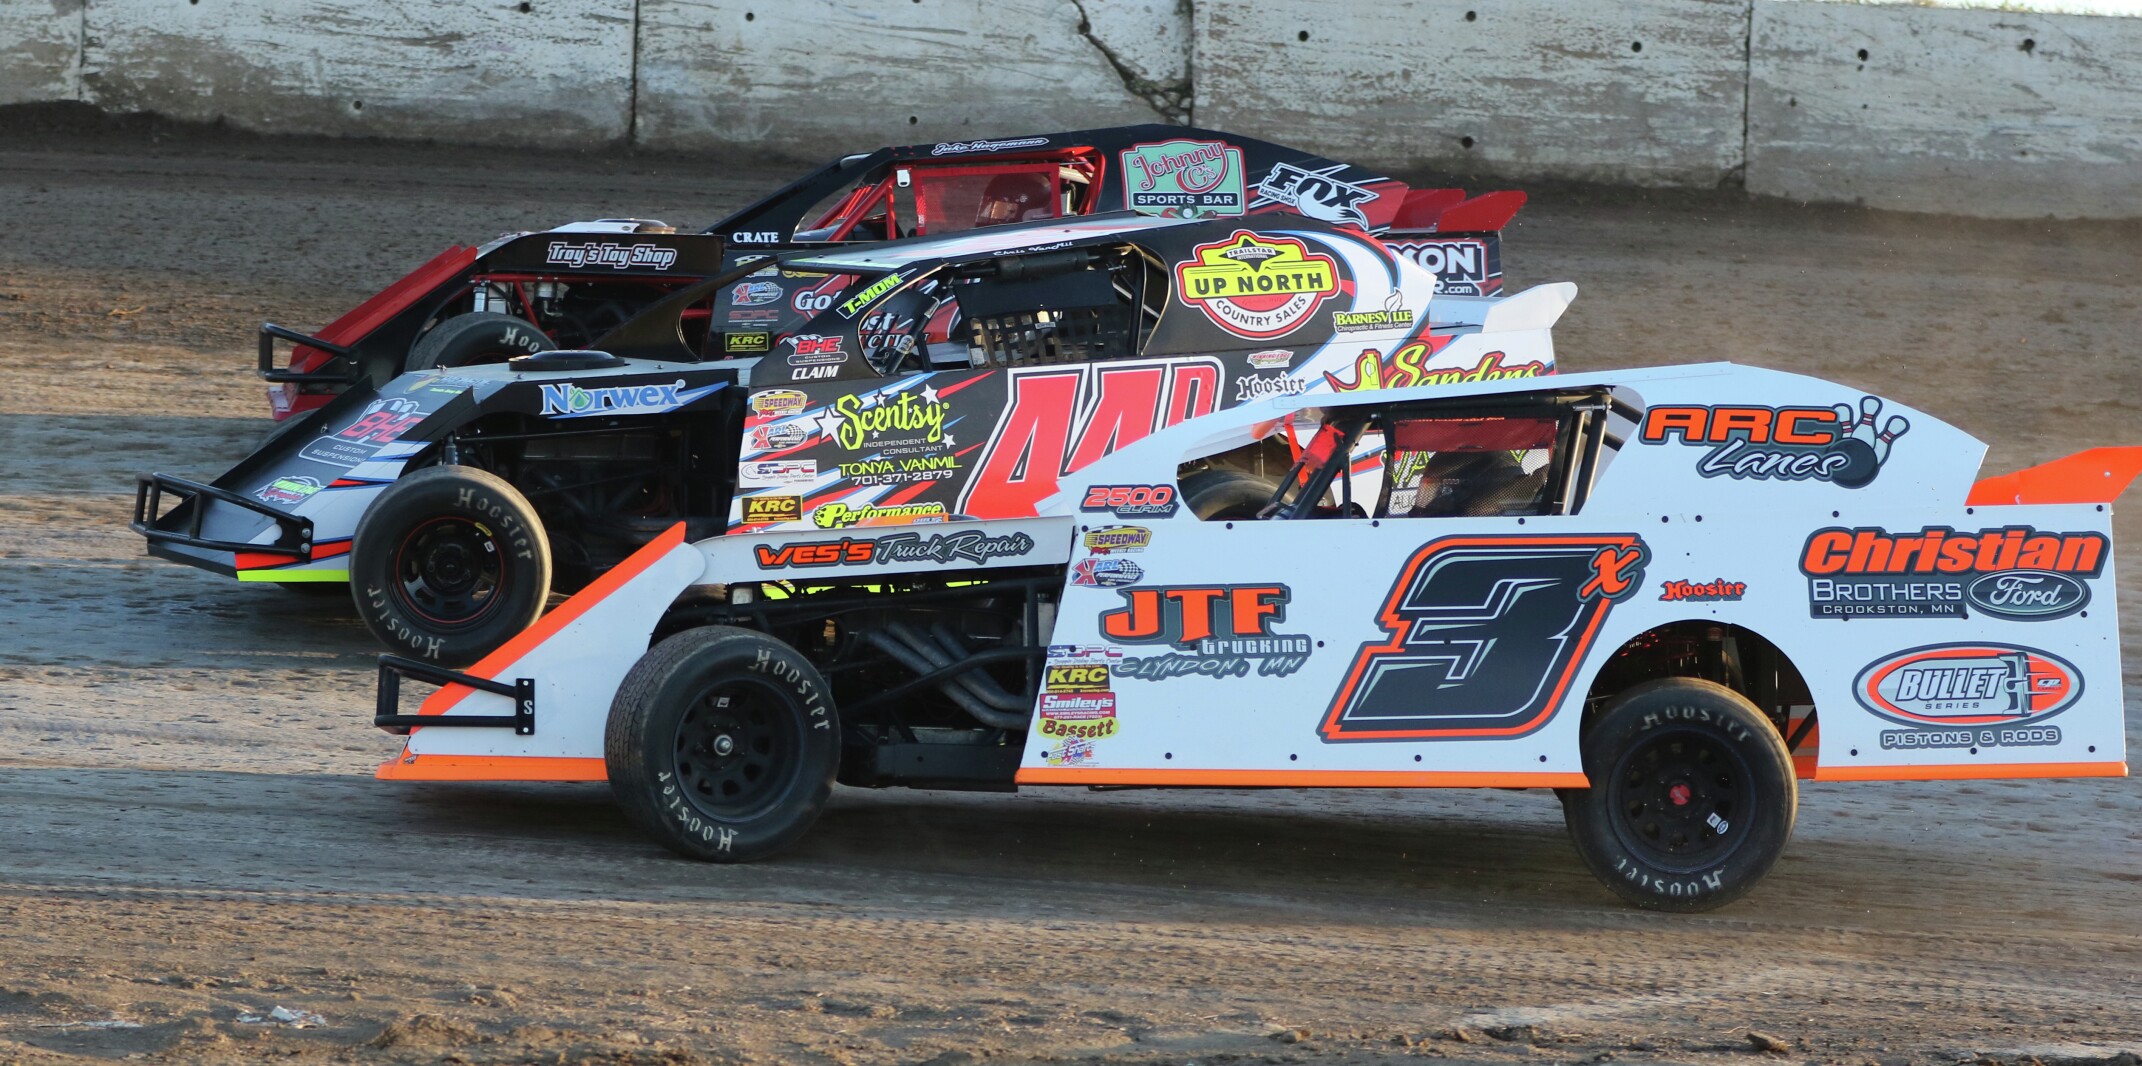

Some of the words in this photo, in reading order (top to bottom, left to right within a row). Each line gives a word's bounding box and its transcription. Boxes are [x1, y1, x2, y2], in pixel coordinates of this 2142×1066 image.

[1132, 142, 1228, 191] Johnny
[1258, 187, 1280, 201] RACING
[1268, 167, 1366, 208] FOX
[1137, 194, 1196, 205] SPORTS
[1203, 194, 1233, 205] BAR
[732, 231, 779, 244] CRATE
[551, 245, 598, 265] Troy's
[602, 246, 629, 266] Toy
[632, 247, 674, 267] Shop
[1227, 247, 1274, 257] TRAILSTAR
[1194, 277, 1227, 295] UP
[1237, 272, 1323, 293] NORTH
[843, 274, 901, 314] T-MOM
[1216, 299, 1271, 326] COUNTRY
[1275, 296, 1307, 323] SALES
[1337, 324, 1368, 332] Chiropractic
[1394, 321, 1413, 329] Center
[729, 336, 765, 345] KRC
[796, 337, 841, 355] BHE
[791, 365, 839, 381] CLAIM
[1237, 373, 1305, 400] Hoosier
[539, 384, 678, 415] Norwex
[764, 397, 803, 408] SPEEDWAY
[836, 391, 945, 451] Scentsy
[1643, 407, 1838, 443] ARC
[333, 443, 367, 455] CUSTOM
[863, 438, 927, 448] INDEPENDENT
[883, 445, 943, 456] CONSULTANT
[838, 460, 895, 476] TONYA
[899, 456, 963, 472] VANMIL
[1703, 439, 1848, 475] Lanes
[851, 469, 954, 486] 701-371-2879
[1083, 486, 1173, 507] 2500
[748, 499, 796, 513] KRC
[826, 502, 942, 528] Performance
[1116, 503, 1172, 514] CLAIM
[1097, 533, 1147, 545] SPEEDWAY
[757, 541, 875, 565] WES'S
[879, 535, 943, 561] Truck
[944, 534, 1031, 561] Repair
[1803, 529, 2104, 574] Christian
[1661, 578, 1746, 601] Hoosier
[1812, 578, 1962, 601] BROTHERS
[1989, 575, 2063, 606] Ford
[1104, 587, 1284, 644] JTF
[1822, 604, 1924, 615] CROOKSTON,
[1931, 604, 1955, 614] MN
[1264, 656, 1302, 673] MN
[1047, 667, 1108, 684] KRC
[1895, 667, 2010, 702] BULLET
[747, 647, 831, 731] Hoosier
[523, 699, 534, 715] S
[1042, 695, 1114, 711] Smiley's
[1924, 702, 1981, 710] SERIES
[1042, 719, 1114, 739] Bassett
[1884, 731, 1972, 746] PISTONS
[1980, 731, 1994, 743] &
[2002, 729, 2058, 743] RODS
